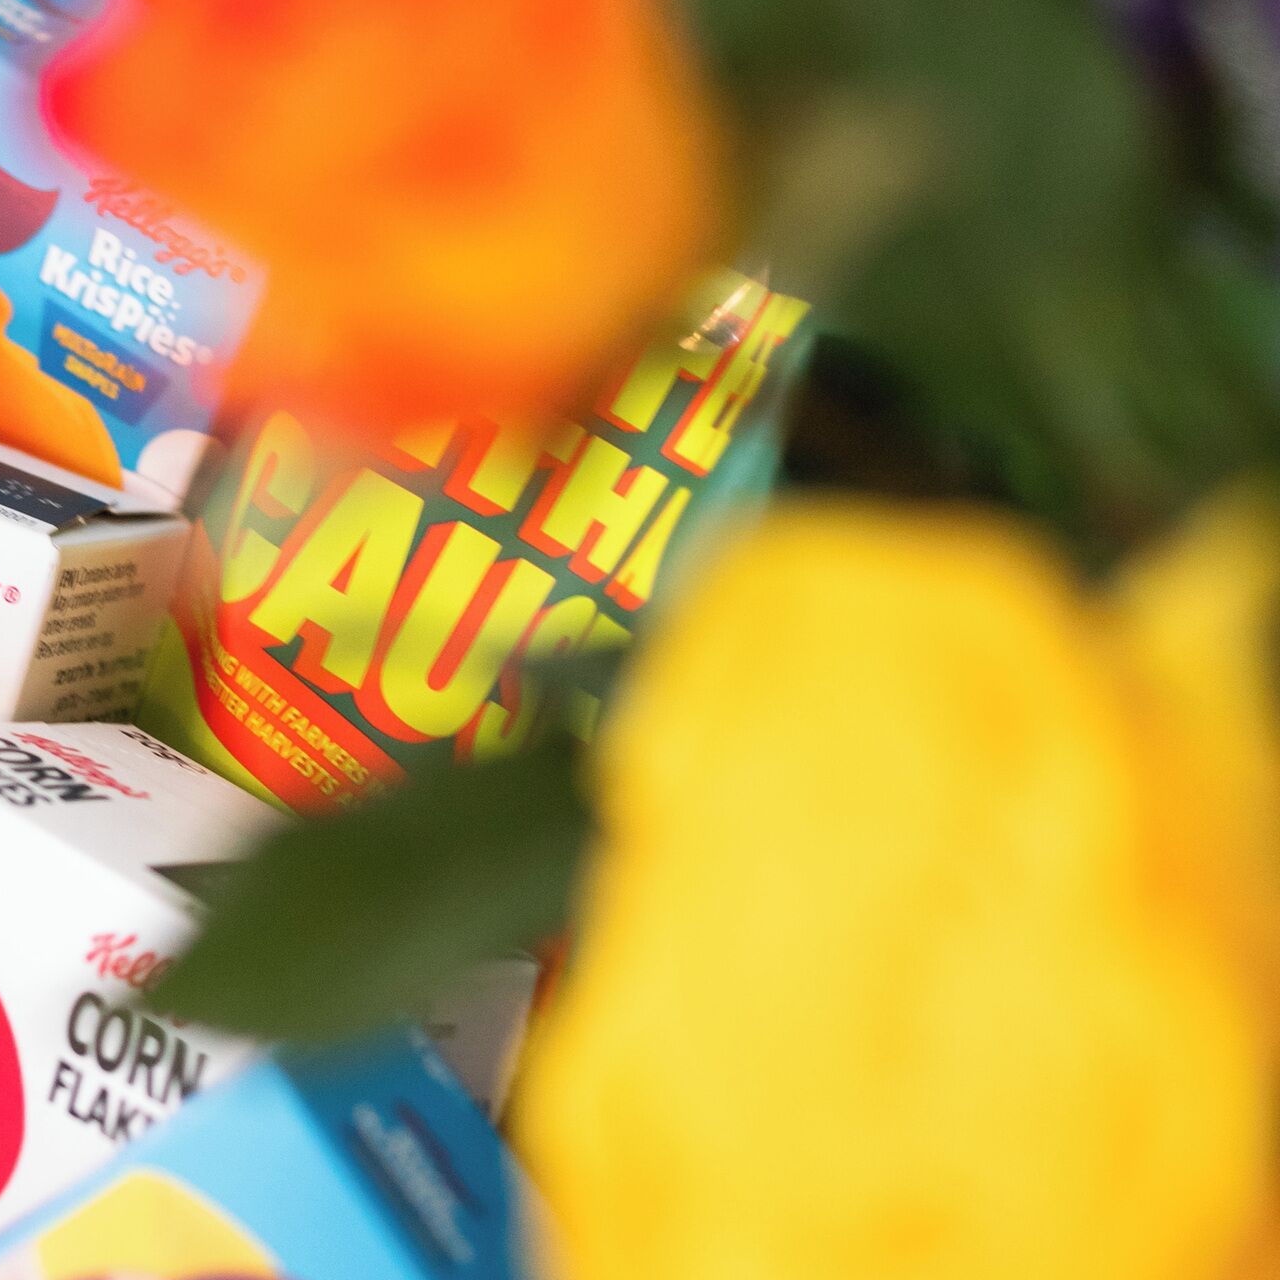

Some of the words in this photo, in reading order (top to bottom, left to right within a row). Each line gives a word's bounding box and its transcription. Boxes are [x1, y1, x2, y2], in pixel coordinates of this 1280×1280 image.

[40, 244, 196, 366] Krispies
[88, 227, 173, 306] Rice
[220, 410, 632, 762] CAUS
[235, 665, 287, 715] WITH
[280, 706, 368, 785] FARMERS
[48, 1058, 153, 1142] FLAK
[67, 991, 208, 1104] CORN
